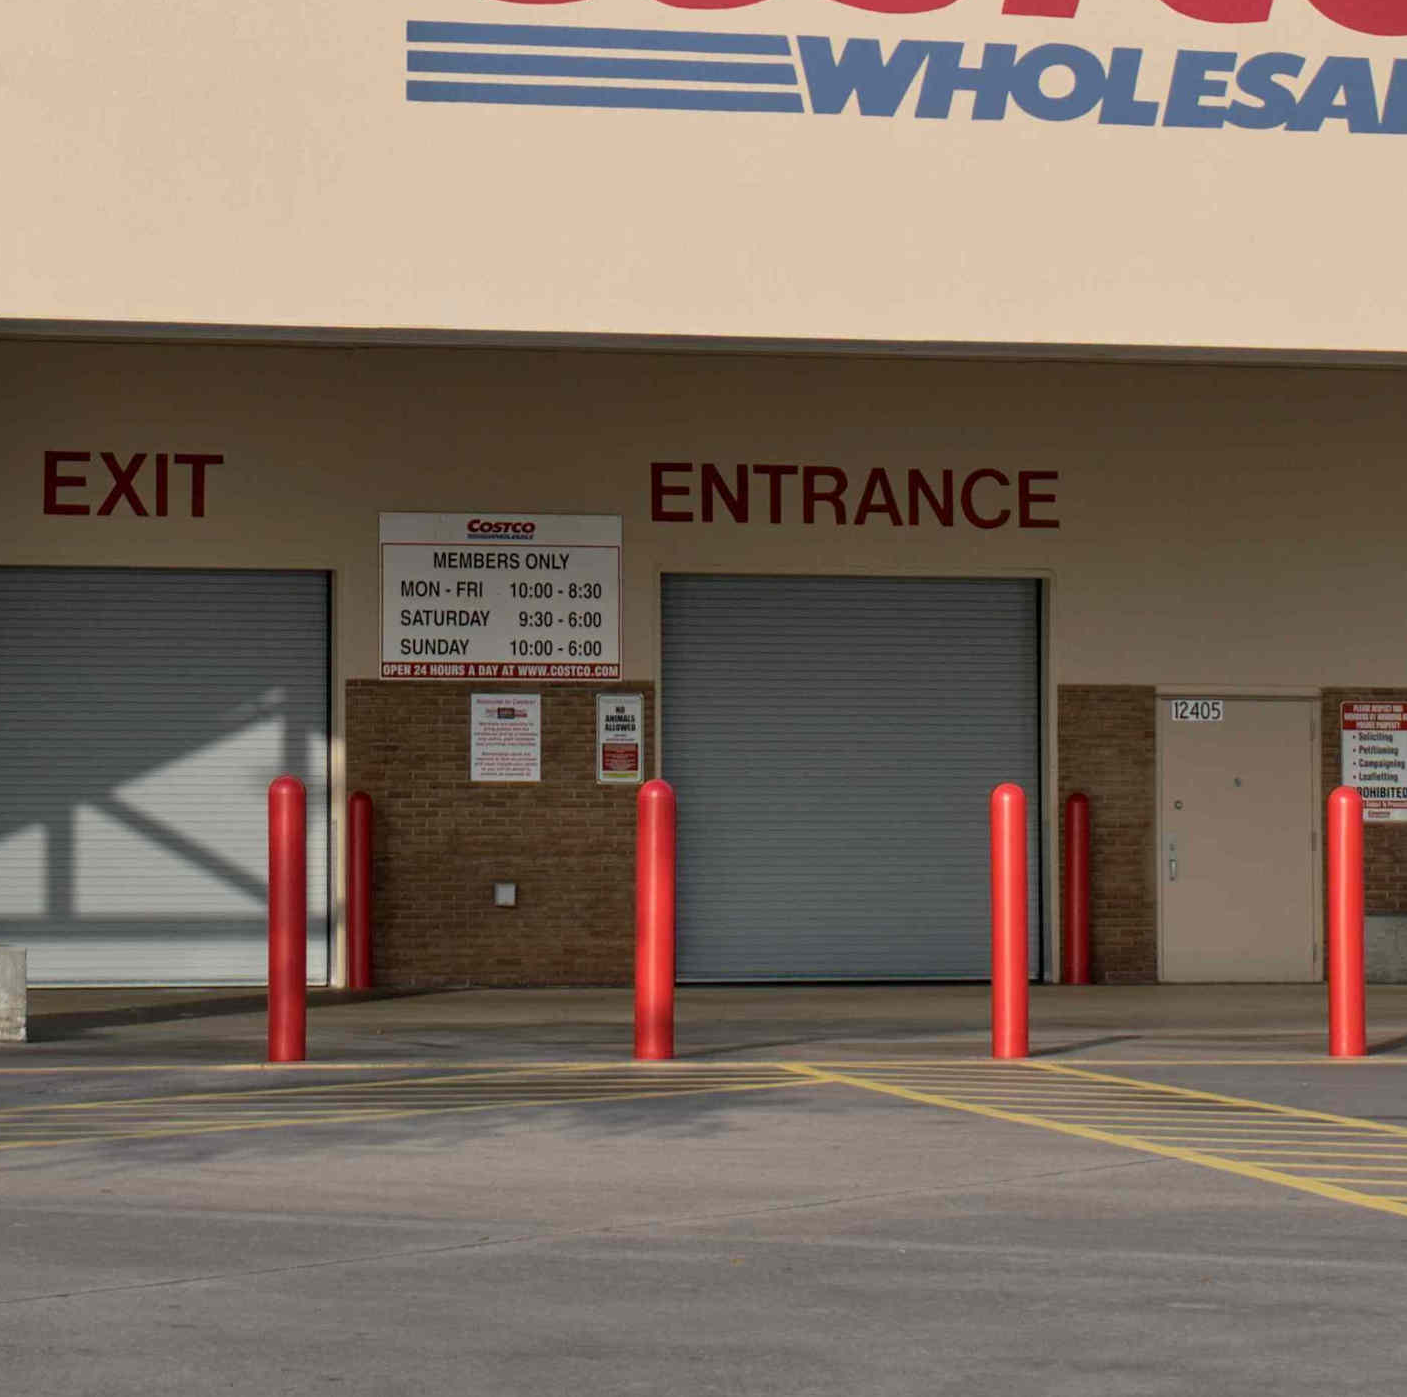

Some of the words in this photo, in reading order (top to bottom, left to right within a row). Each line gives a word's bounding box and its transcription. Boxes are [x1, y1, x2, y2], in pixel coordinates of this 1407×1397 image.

[44, 451, 224, 517] EXIT
[651, 462, 1059, 529] ENTRANCE
[468, 519, 535, 534] COSTCO
[434, 552, 519, 569] MEMBERS
[526, 554, 569, 569] ONLY
[401, 581, 439, 596] MON
[457, 582, 482, 597] FRI
[511, 583, 552, 598] 10:00
[569, 583, 601, 599] 8:30
[401, 610, 489, 626] SATURDAY
[519, 611, 553, 627] 9:30
[569, 612, 601, 627] 6:00
[401, 639, 469, 655] SUNDAY
[511, 640, 552, 656] 10:00
[569, 641, 601, 656] 6:00
[383, 664, 411, 677] OPEN
[413, 664, 428, 677] 24
[430, 664, 465, 677] HOURS
[468, 664, 476, 677] A
[478, 664, 498, 677] DAY
[501, 664, 515, 677] AT
[517, 664, 618, 677] WWW.COSTCO.COM
[1174, 701, 1221, 720] 12405
[605, 723, 636, 731] ALLOWED
